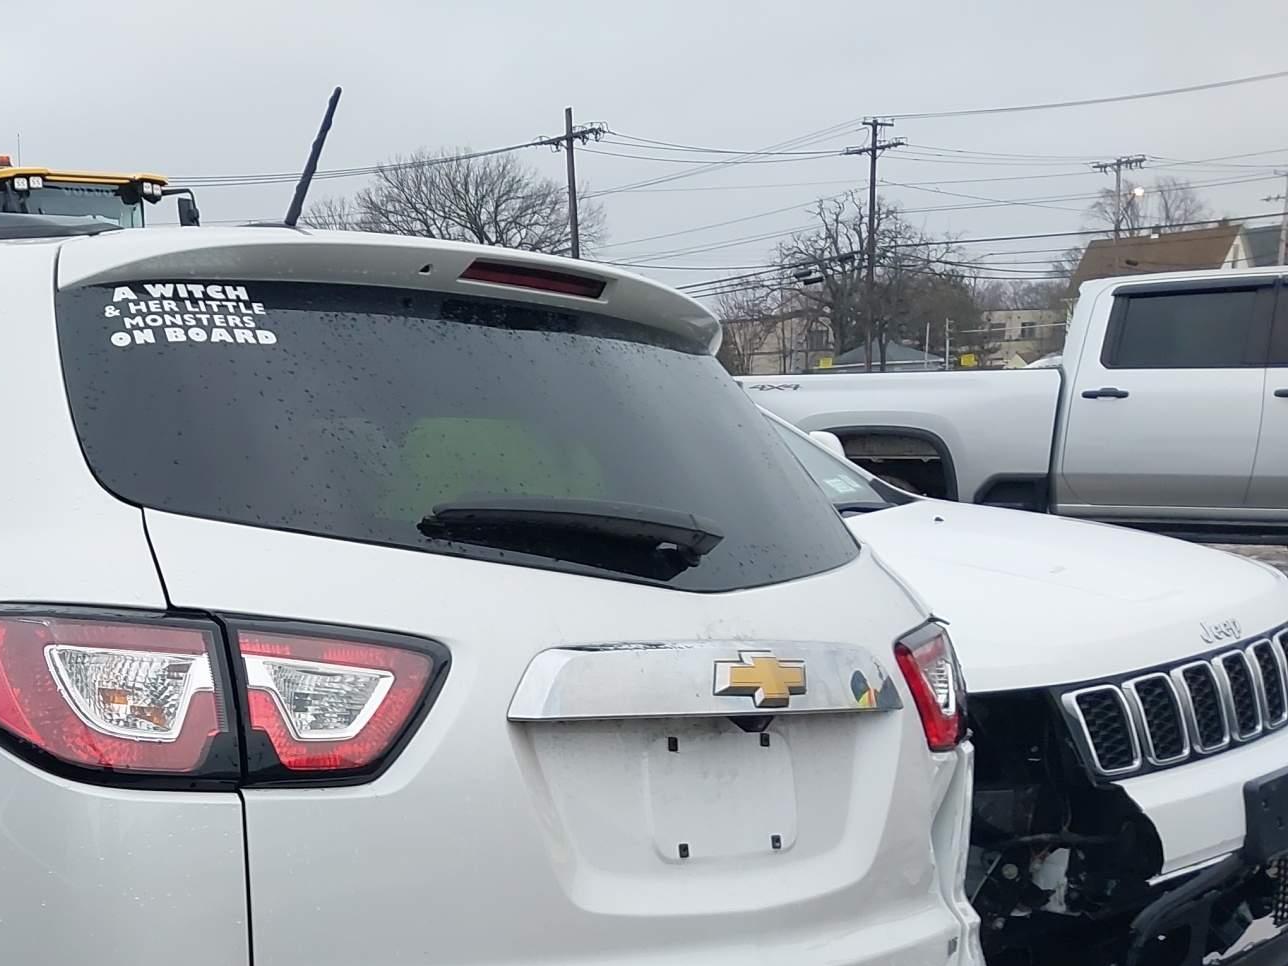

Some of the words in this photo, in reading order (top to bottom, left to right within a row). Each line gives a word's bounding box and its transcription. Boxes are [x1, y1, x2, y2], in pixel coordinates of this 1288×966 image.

[113, 286, 137, 302] A
[144, 283, 249, 301] WITCH
[104, 305, 120, 317] &
[128, 300, 180, 314] HER
[184, 300, 266, 315] LITTLE
[123, 314, 256, 329] MONSTERS
[111, 328, 155, 347] ON
[164, 327, 277, 345] BOARD
[1200, 618, 1241, 643] Jeep
